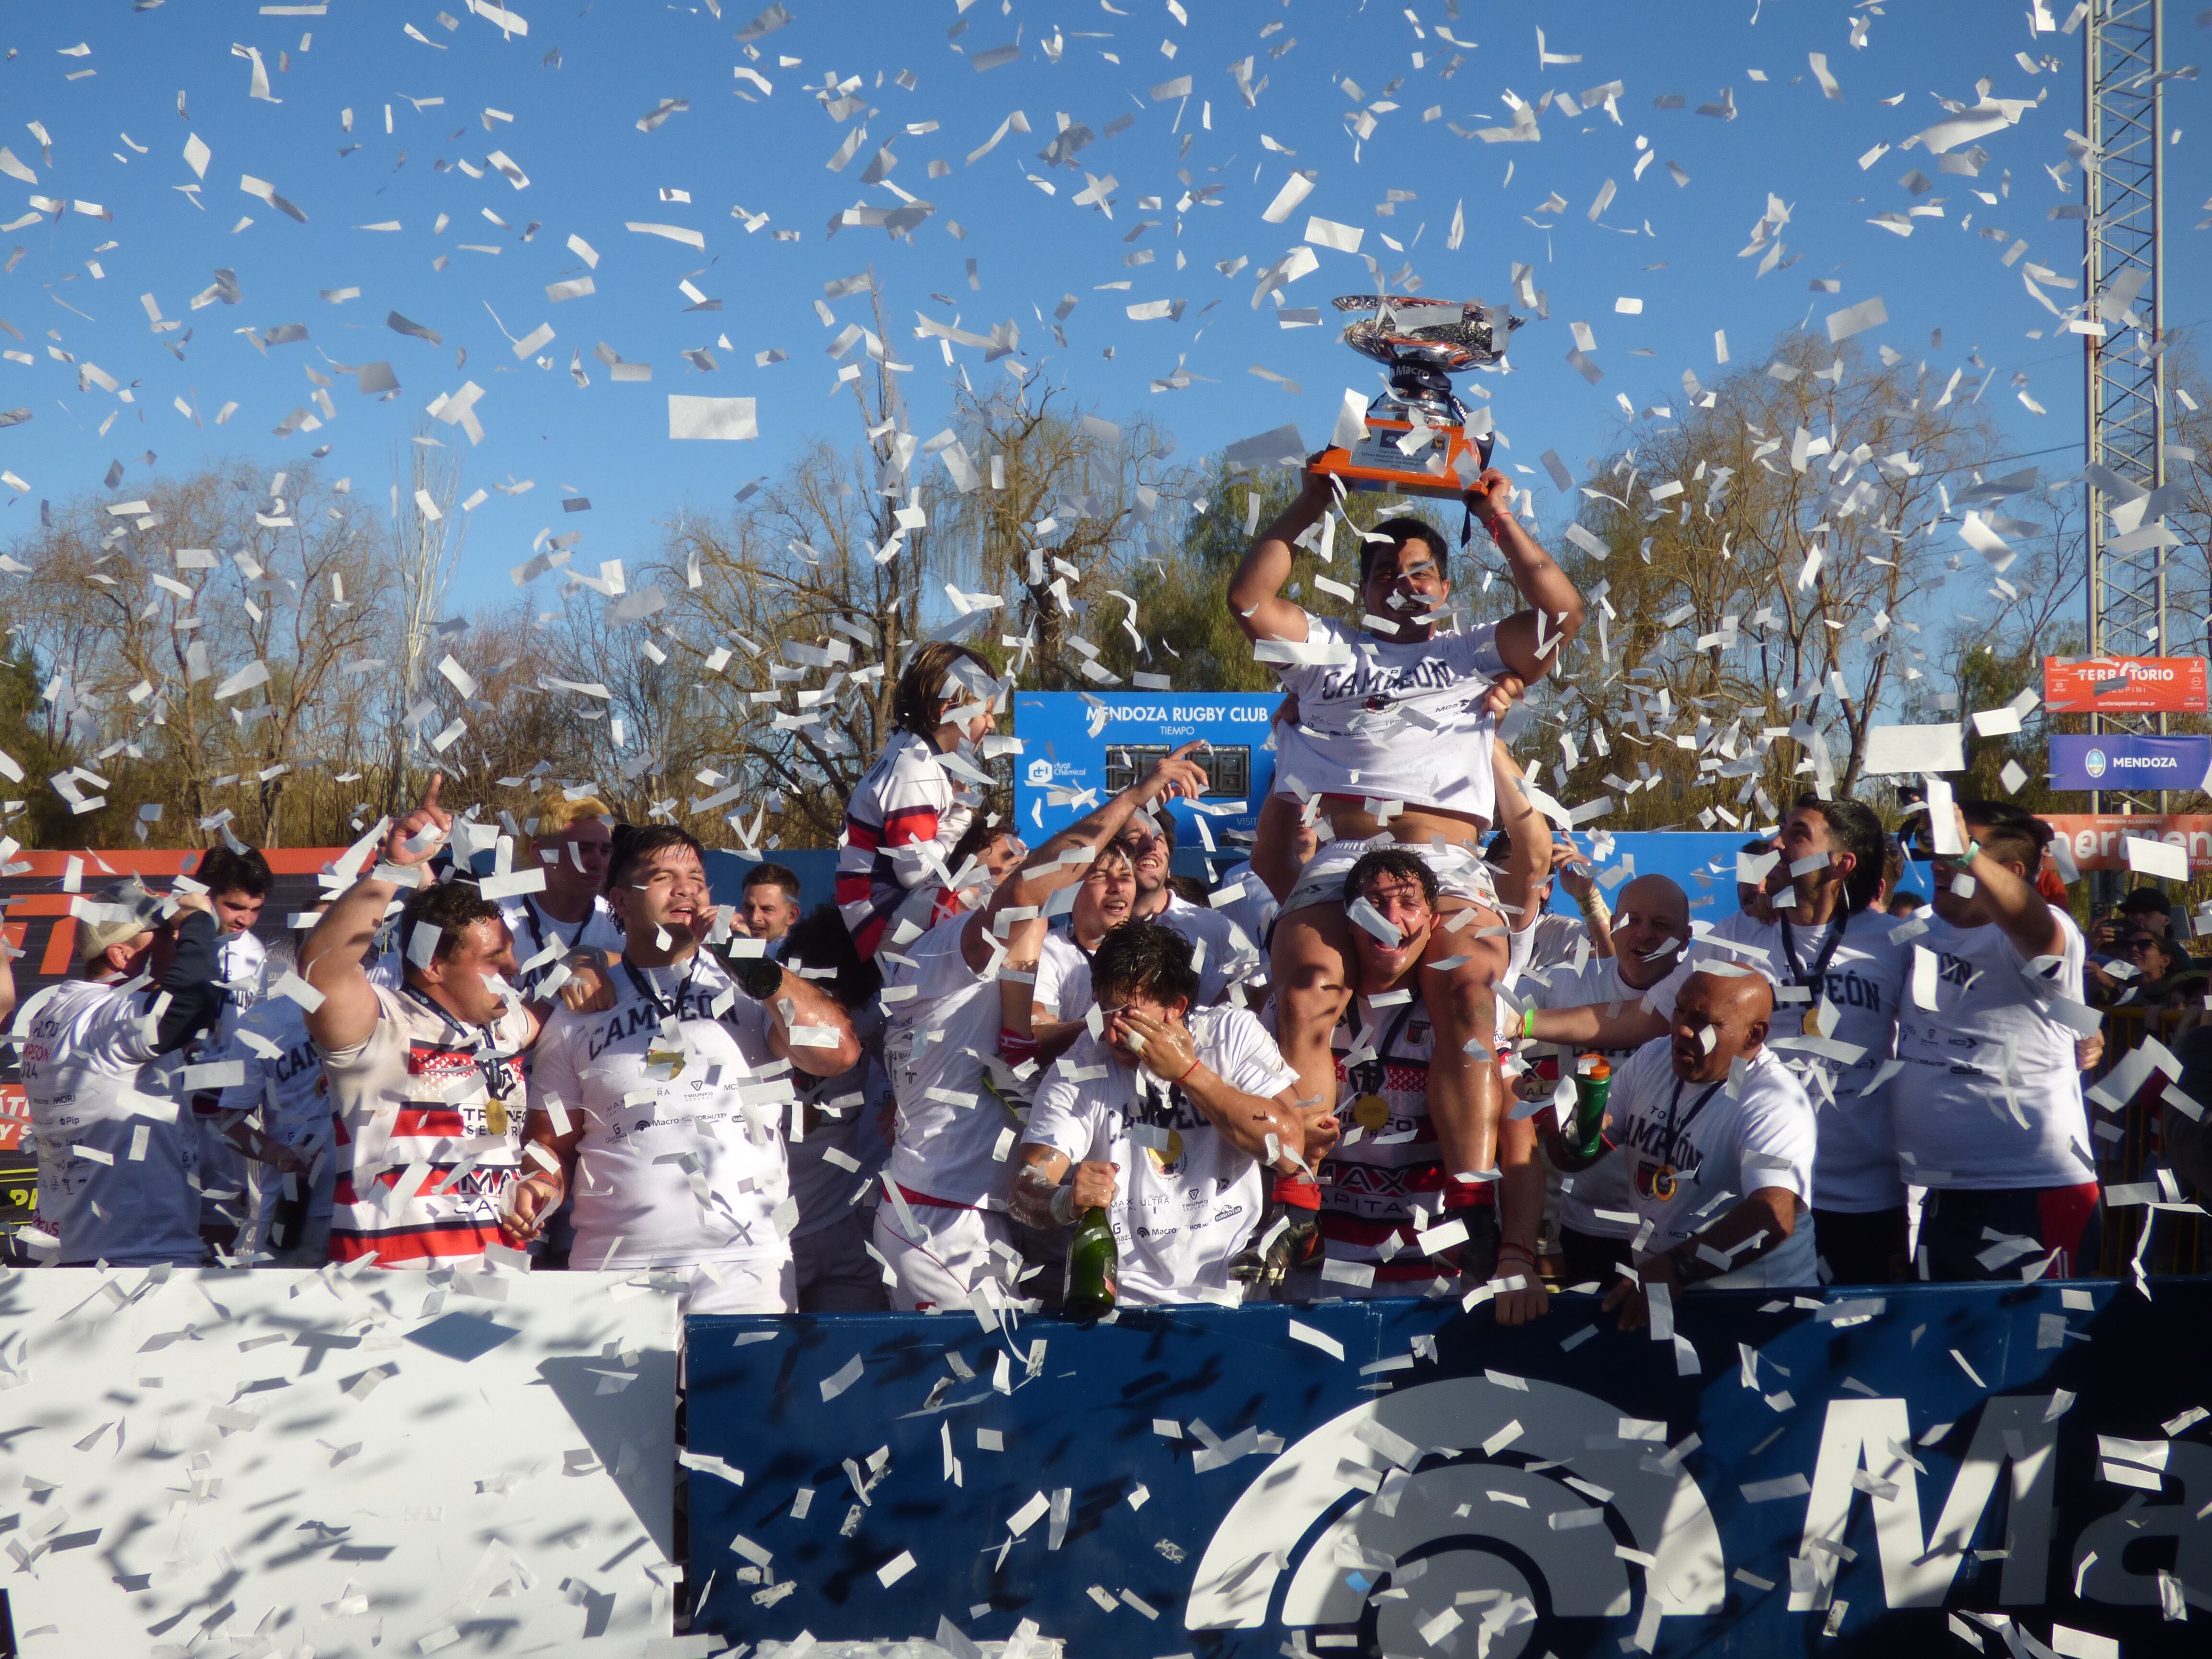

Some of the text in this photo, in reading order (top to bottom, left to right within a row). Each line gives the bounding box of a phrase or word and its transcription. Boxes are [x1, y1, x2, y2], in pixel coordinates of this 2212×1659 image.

[1396, 364, 1430, 380] Macro
[1173, 707, 1226, 721] RUGBY
[1230, 707, 1268, 721] CLUB
[1160, 726, 1195, 735] TIEMPO
[2113, 757, 2177, 768] MENDOZA
[53, 1094, 76, 1105] MORI
[66, 1116, 80, 1126] Pip
[652, 1118, 679, 1127] Macro
[1140, 1198, 1170, 1206] ULTRA
[1182, 1200, 1208, 1208] TRIUNFO
[1113, 1222, 1121, 1235] G
[1152, 1227, 1177, 1236] Macro
